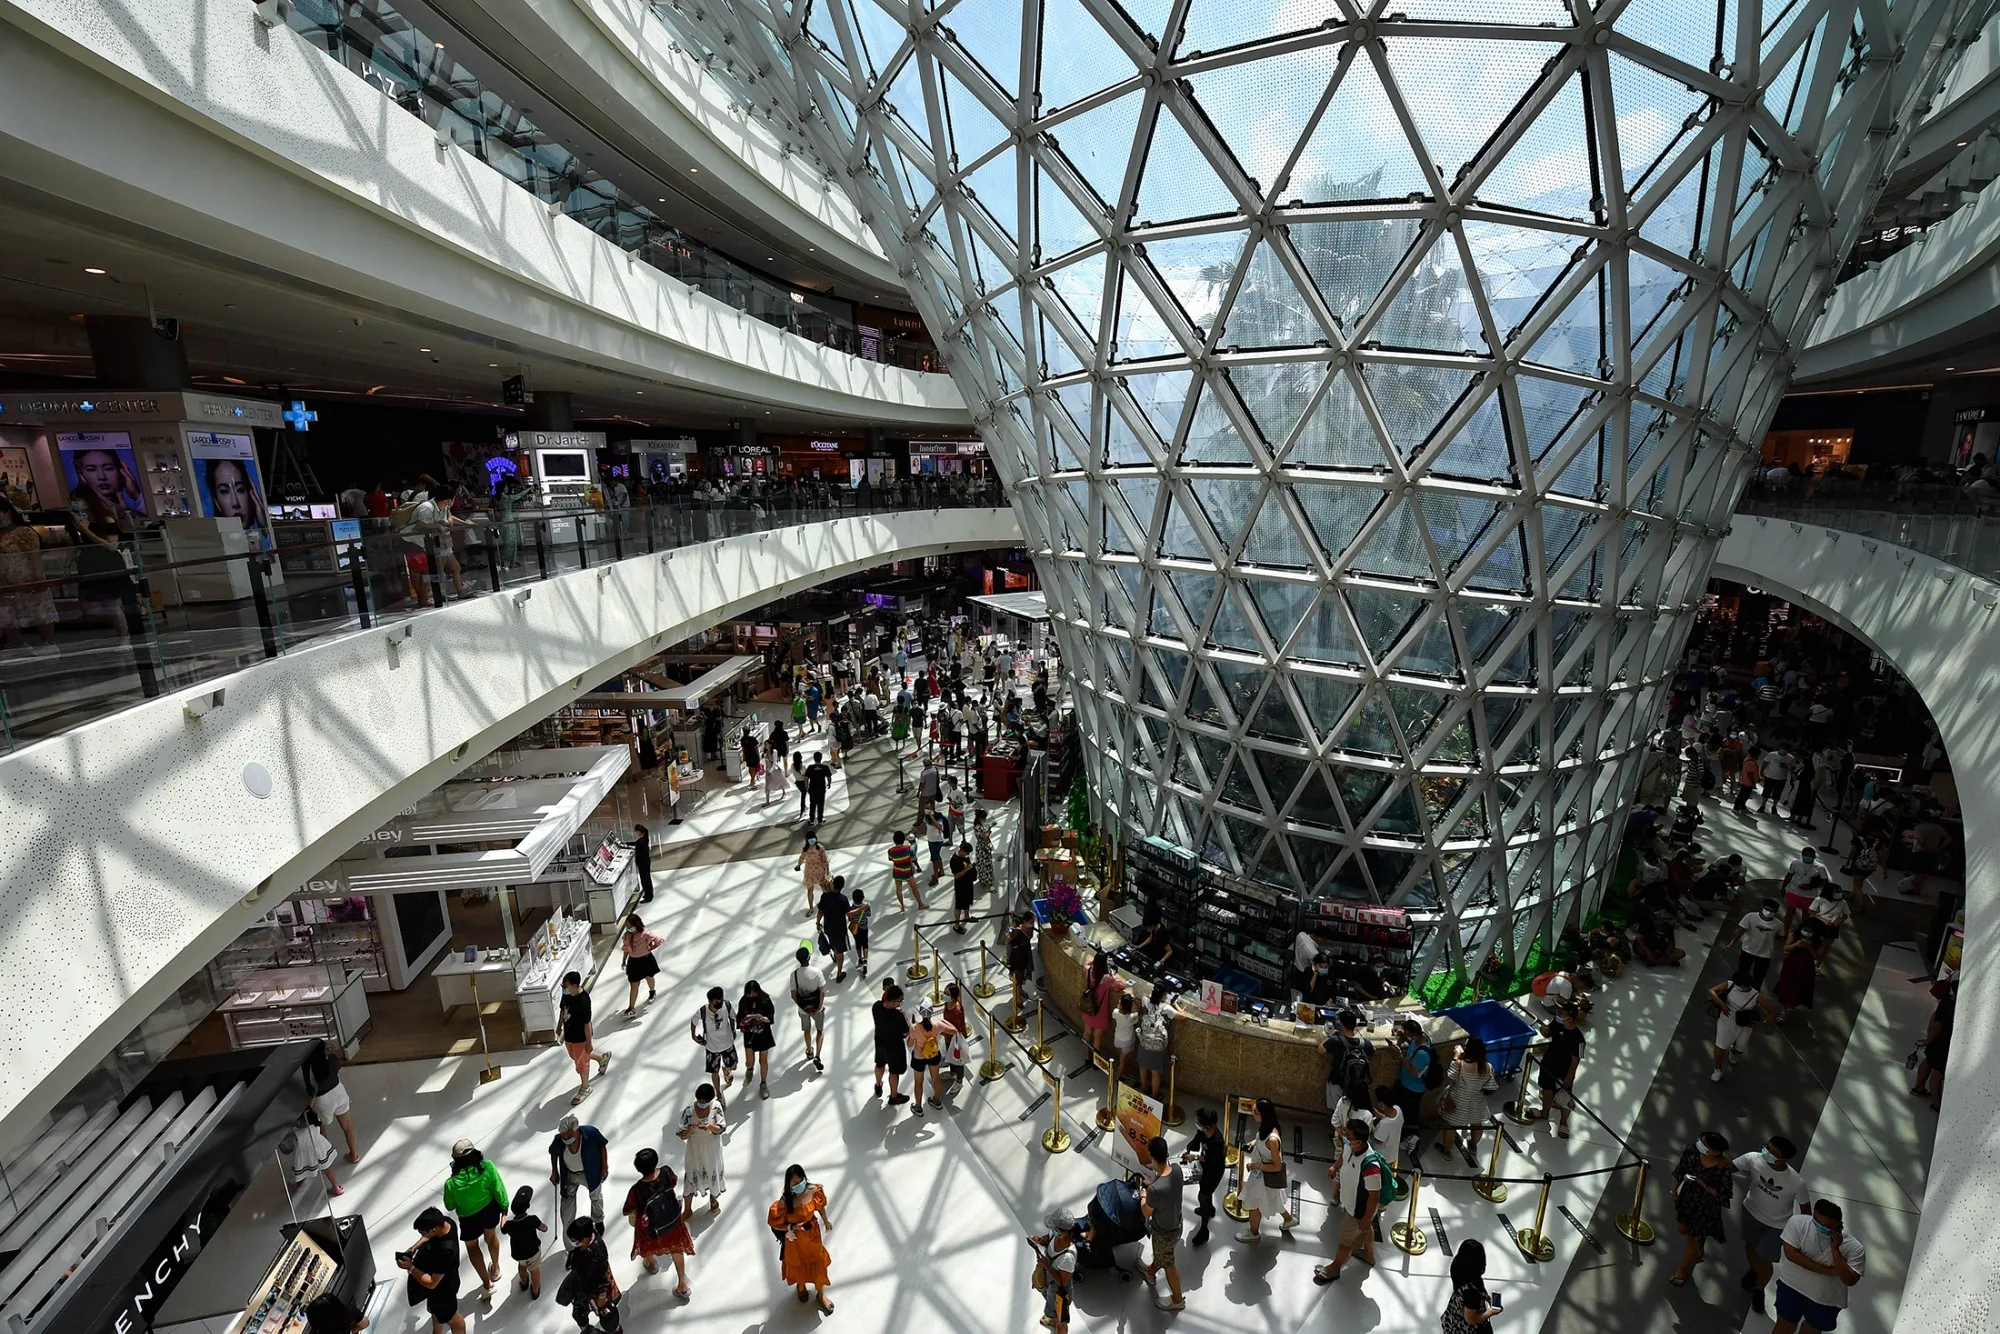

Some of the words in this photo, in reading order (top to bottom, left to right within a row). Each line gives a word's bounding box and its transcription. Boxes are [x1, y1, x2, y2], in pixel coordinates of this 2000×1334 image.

[20, 401, 82, 414] DERMA
[95, 400, 161, 413] CENTER
[201, 402, 235, 417] DERMA
[242, 407, 275, 421] CENTER
[1129, 1128, 1147, 1145] 8.5
[1757, 1184, 1779, 1200] adidas
